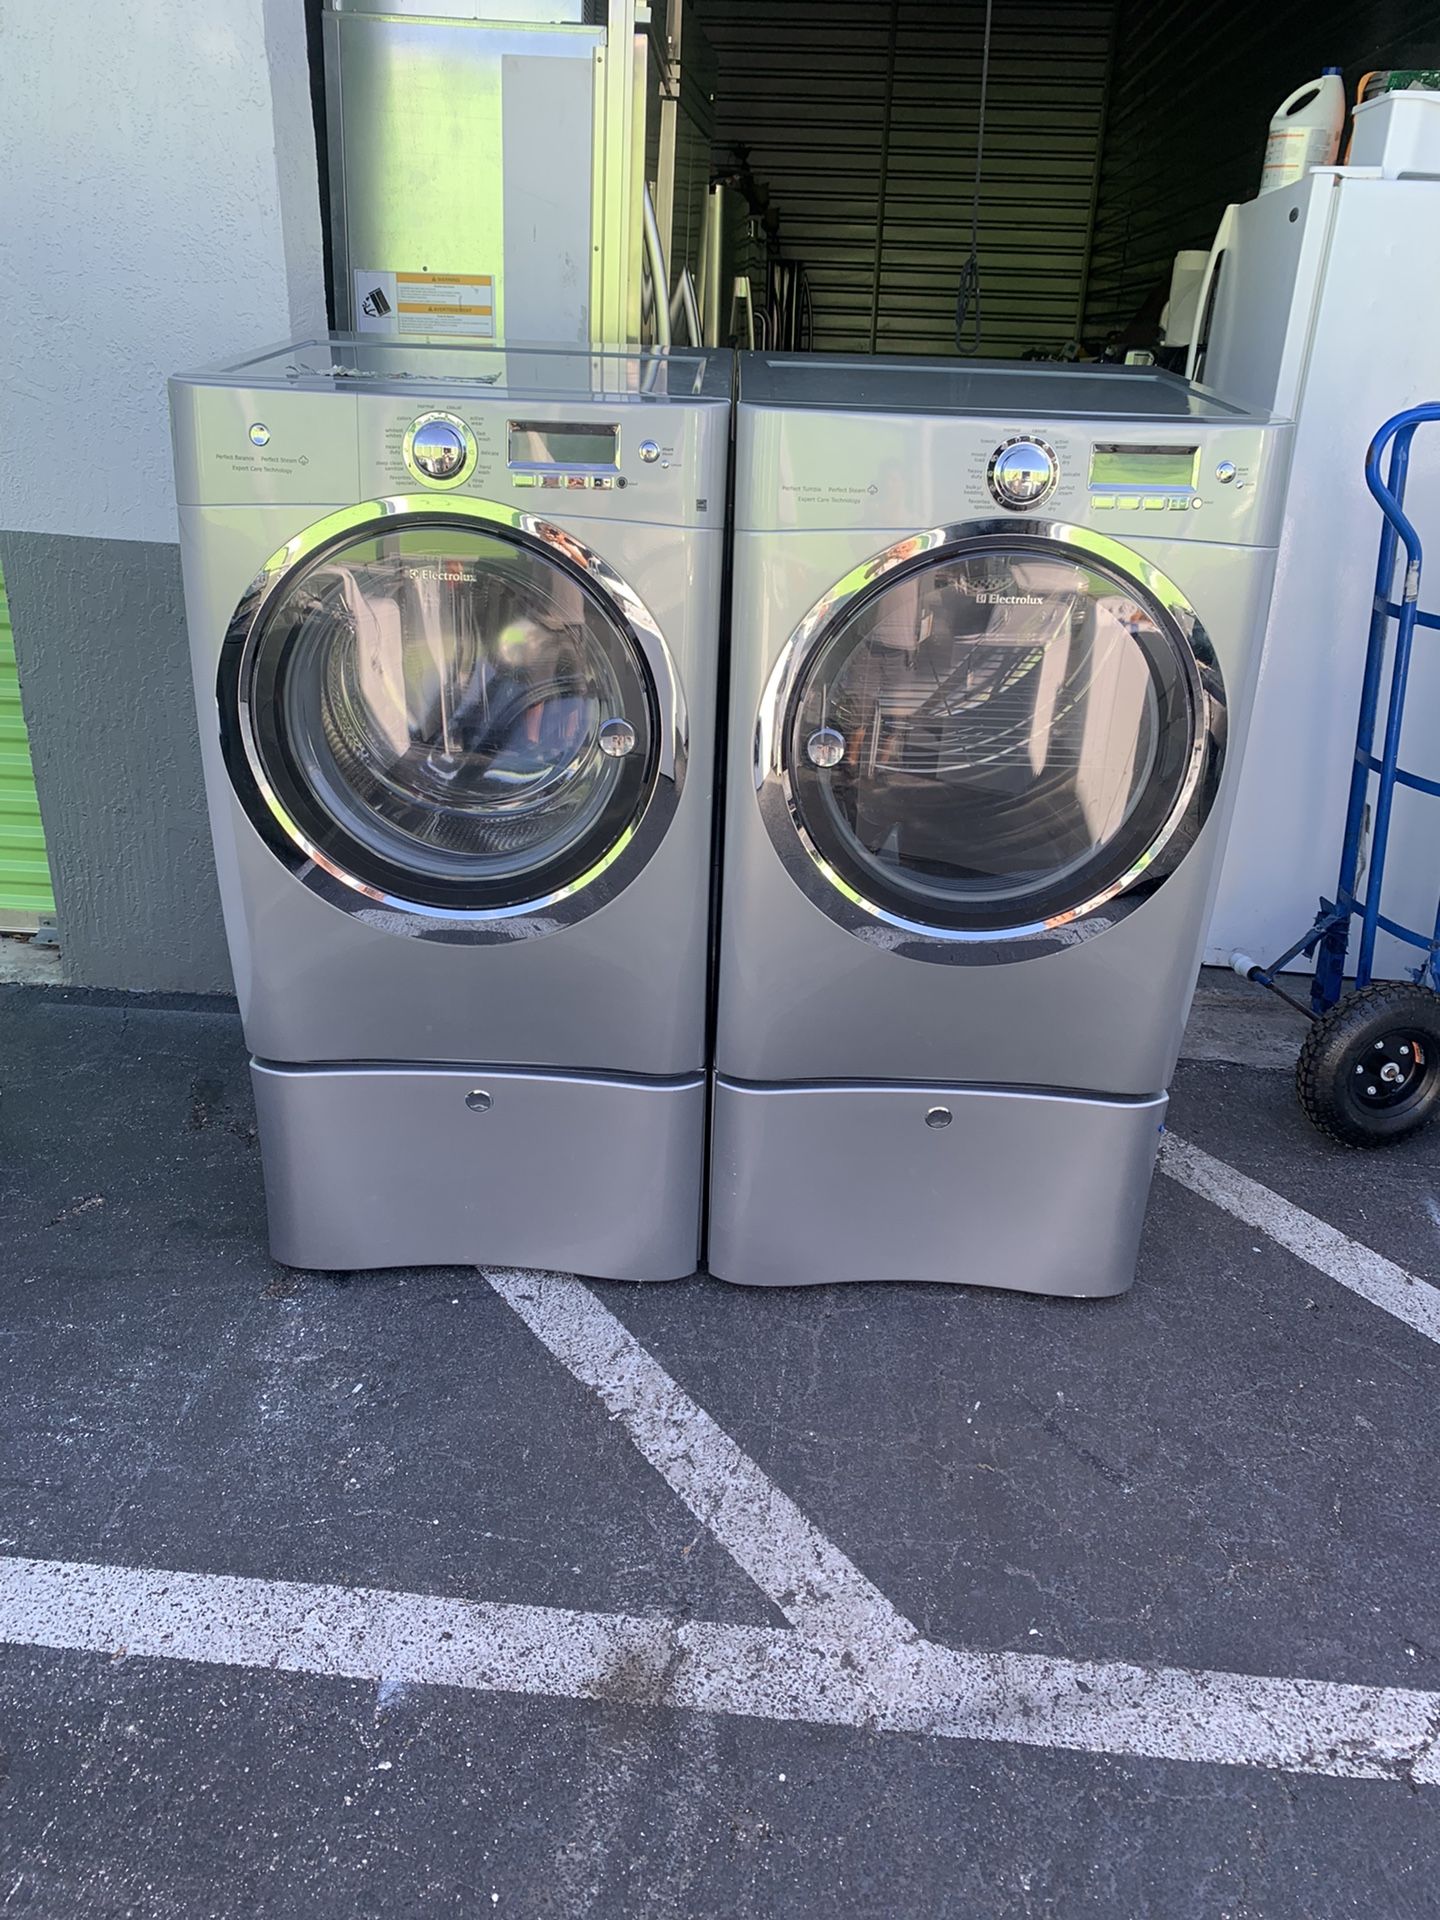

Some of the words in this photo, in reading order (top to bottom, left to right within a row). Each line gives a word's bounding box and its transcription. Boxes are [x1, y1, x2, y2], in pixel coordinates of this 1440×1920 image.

[263, 466, 293, 474] Technology
[831, 497, 861, 505] Technology
[422, 569, 477, 582] Electrolux
[988, 594, 1044, 605] Electrolux
